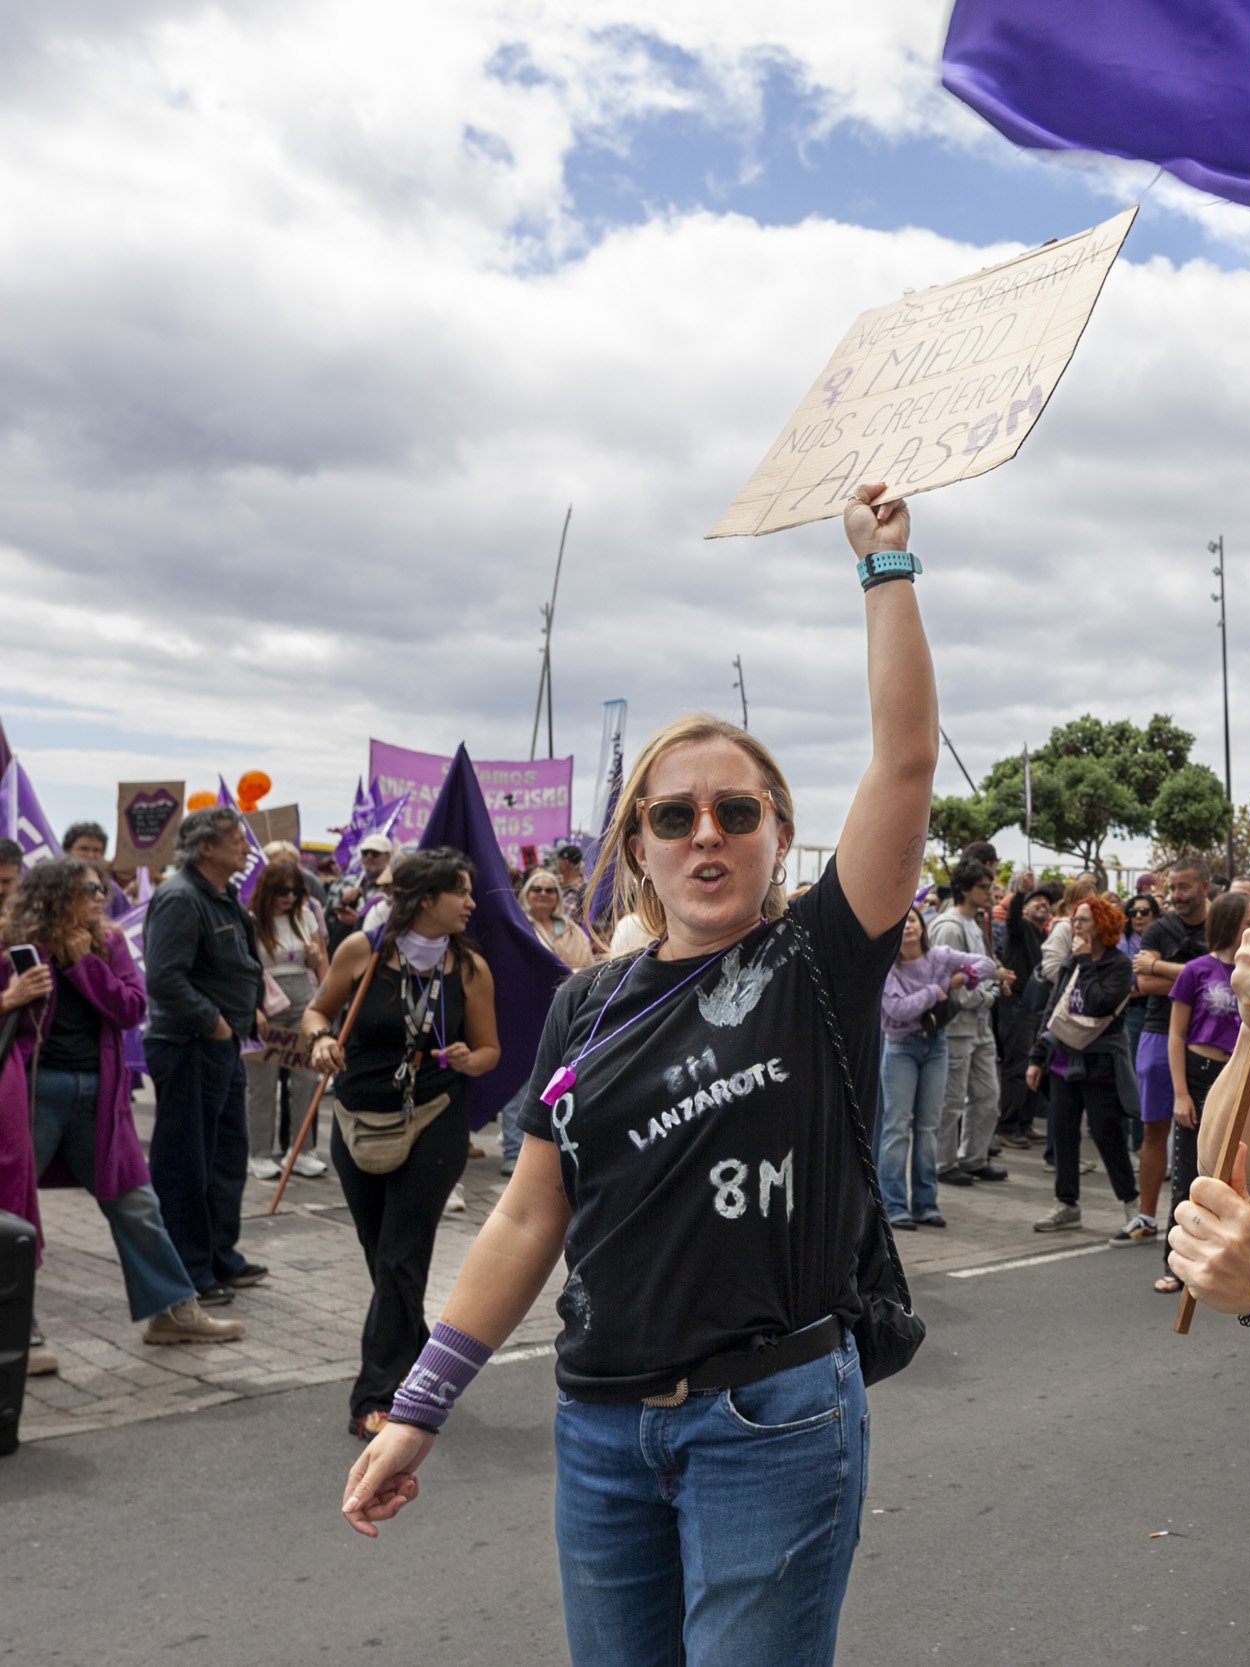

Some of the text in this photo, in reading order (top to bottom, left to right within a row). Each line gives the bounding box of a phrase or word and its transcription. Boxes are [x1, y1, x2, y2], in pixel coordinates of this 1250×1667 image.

[842, 305, 924, 355] NOS
[772, 413, 856, 460] NOS
[962, 384, 1044, 456] 8M
[790, 422, 970, 511] ALAS
[628, 1057, 789, 1151] LANZAROTE
[710, 1148, 795, 1223] 8M
